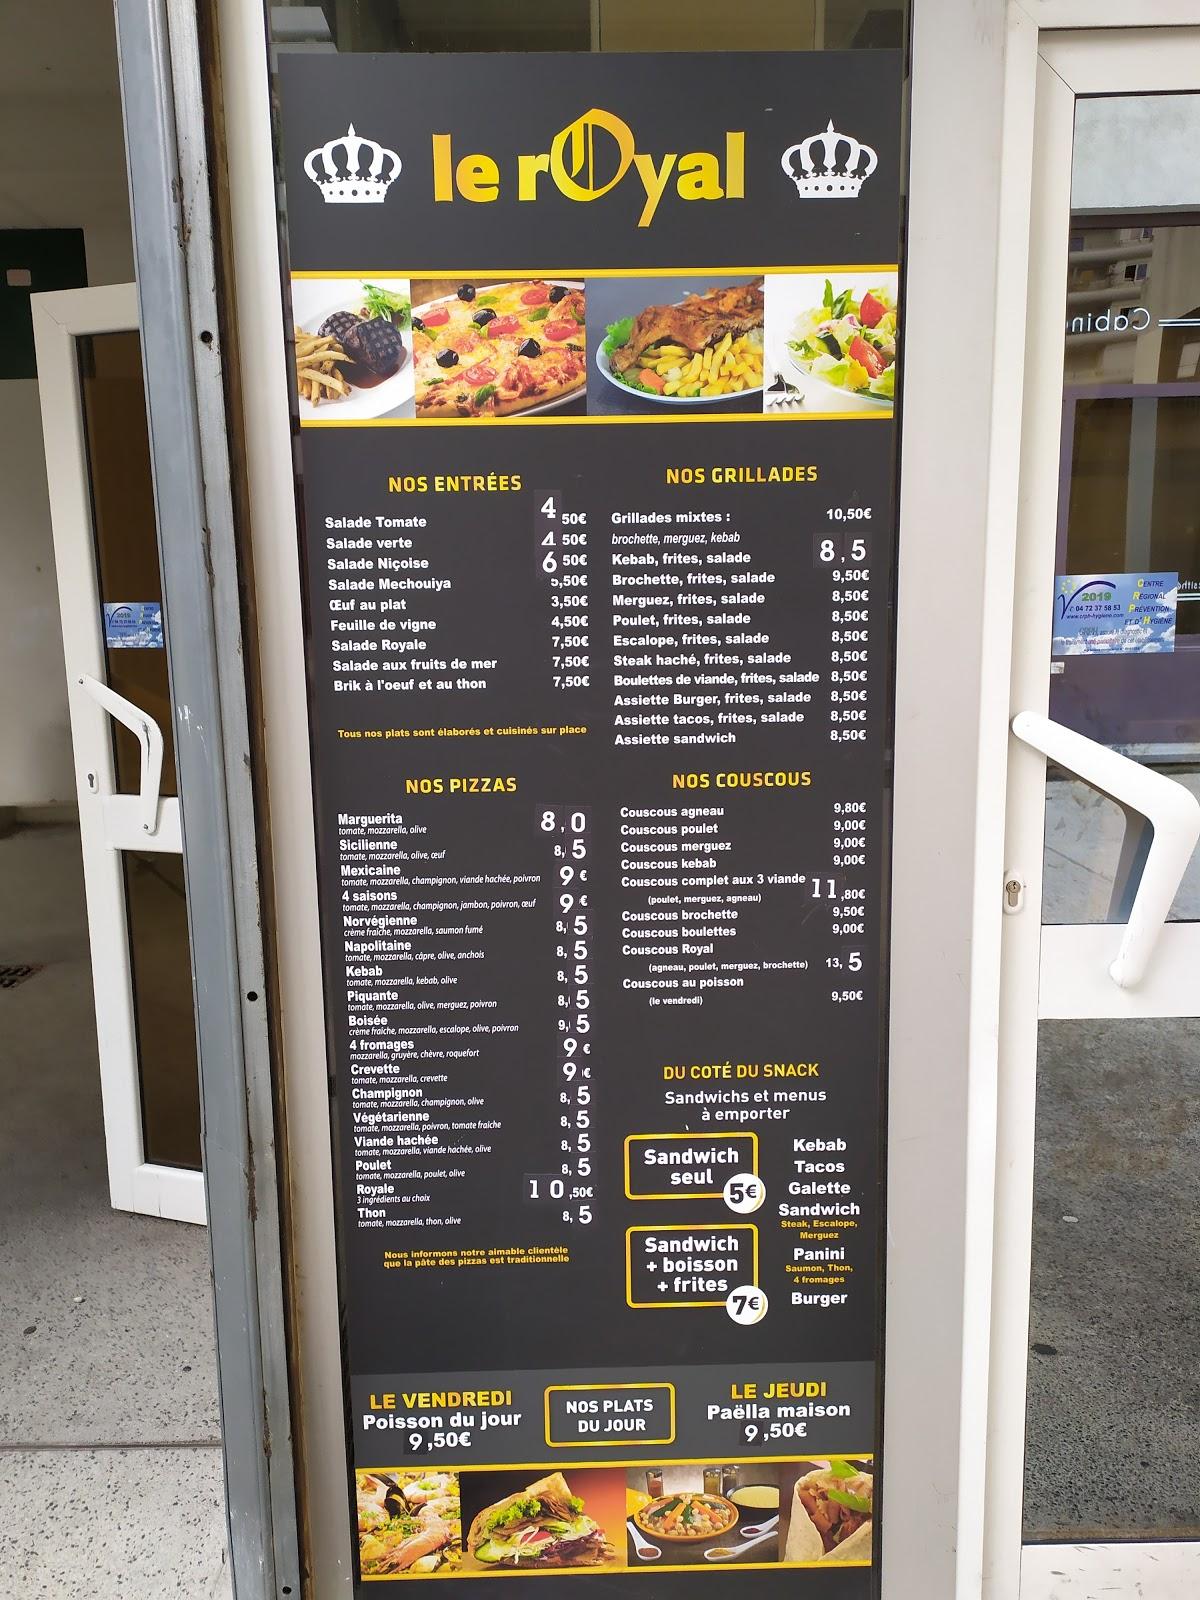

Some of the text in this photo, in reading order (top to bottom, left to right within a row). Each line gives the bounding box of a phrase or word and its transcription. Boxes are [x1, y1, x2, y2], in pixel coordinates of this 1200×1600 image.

[432, 134, 499, 202] le
[389, 472, 521, 492] NOS ENTRÉES
[667, 466, 817, 484] NOS GRILLADES
[325, 516, 427, 528] Salade Tomate
[611, 511, 722, 524] Grillades mixtes
[827, 508, 872, 522] 10,50€
[612, 531, 740, 546] brochette, merguez, kebab
[328, 557, 429, 572] Salade Niçoise
[612, 552, 751, 566] Kebab, frites, salade
[832, 569, 869, 583] 9,50€
[329, 578, 451, 592] Salade Mechouiya
[1137, 579, 1164, 588] CENTRE
[551, 595, 588, 609] 3,50€
[1081, 592, 1112, 601] 2019
[329, 599, 406, 612] Œuf au plat
[552, 636, 589, 649] 7,50€
[832, 630, 868, 644] 8,50€
[552, 656, 589, 669] 7,50€
[334, 678, 486, 691] Brik à l'oeuf et au thon
[338, 730, 362, 738] Tous
[385, 729, 410, 739] plats
[413, 728, 435, 736] sont
[437, 728, 481, 736] élaborés
[483, 727, 494, 735] et
[496, 726, 538, 735] cuisinés
[560, 725, 587, 736] place
[615, 732, 736, 745] Assiette sandwich
[406, 777, 516, 793] NOS PIZZAS
[673, 772, 811, 788] NOS COUSCOUS
[620, 807, 724, 819] Couscous agneau
[834, 802, 866, 815] 9,80€
[338, 813, 402, 826] Marguerita
[339, 825, 427, 835] tomate, mozzarella, olive
[340, 839, 398, 851] Sicilienne
[341, 864, 401, 876] Mexicaine
[621, 873, 806, 888] Couscous complet aux 3 viande
[342, 890, 397, 901] 4 saisons
[648, 893, 761, 905] (poulet, merguez, agneau)
[343, 898, 536, 912] tomate, mozzarella, champignon, jambon, poivron, œuf
[833, 906, 864, 918] 9,50€
[343, 915, 417, 928] Norvégienne
[345, 940, 411, 953] Napolitaine
[622, 943, 713, 956] Couscous Royal
[649, 996, 703, 1007] (le vendredi)
[832, 990, 863, 1003] 9,50€
[349, 1039, 414, 1051] 4 fromages
[350, 1048, 480, 1061] mozzarella, gruyère, chèvre, roquefort
[664, 1061, 819, 1079] DU COTÉ DU SNACK
[352, 1087, 422, 1100] Champignon
[665, 1090, 826, 1104] Sandwichs et menus
[353, 1111, 430, 1124] Végétarienne
[702, 1107, 790, 1123] à emporter
[794, 1138, 846, 1152] Kebab
[644, 1147, 738, 1165] Sandwich
[794, 1160, 845, 1173] Tacos
[671, 1168, 713, 1185] seul
[729, 1183, 757, 1204] 5€
[788, 1182, 851, 1195] Galette
[778, 1202, 860, 1216] Sandwich
[781, 1220, 857, 1228] Steak, Escalope,
[800, 1232, 839, 1240] Merguez
[645, 1235, 738, 1253] Sandwich
[794, 1247, 844, 1260] Panini
[384, 1261, 401, 1269] que
[415, 1258, 436, 1268] pâte
[458, 1257, 487, 1267] pizzas
[490, 1256, 504, 1264] est
[507, 1255, 569, 1263] traditionnelle
[663, 1256, 738, 1273] boisson
[674, 1276, 728, 1292] frites
[732, 1296, 759, 1315] 7€
[792, 1292, 848, 1307] Burger
[732, 1382, 826, 1399] LE JEUDI
[370, 1390, 511, 1409] LE VENDREDI
[566, 1399, 653, 1414] NOS PLATS
[708, 1402, 850, 1420] Paëlla maison
[363, 1411, 522, 1430] Poisson du jour
[578, 1418, 646, 1432] DU JOUR
